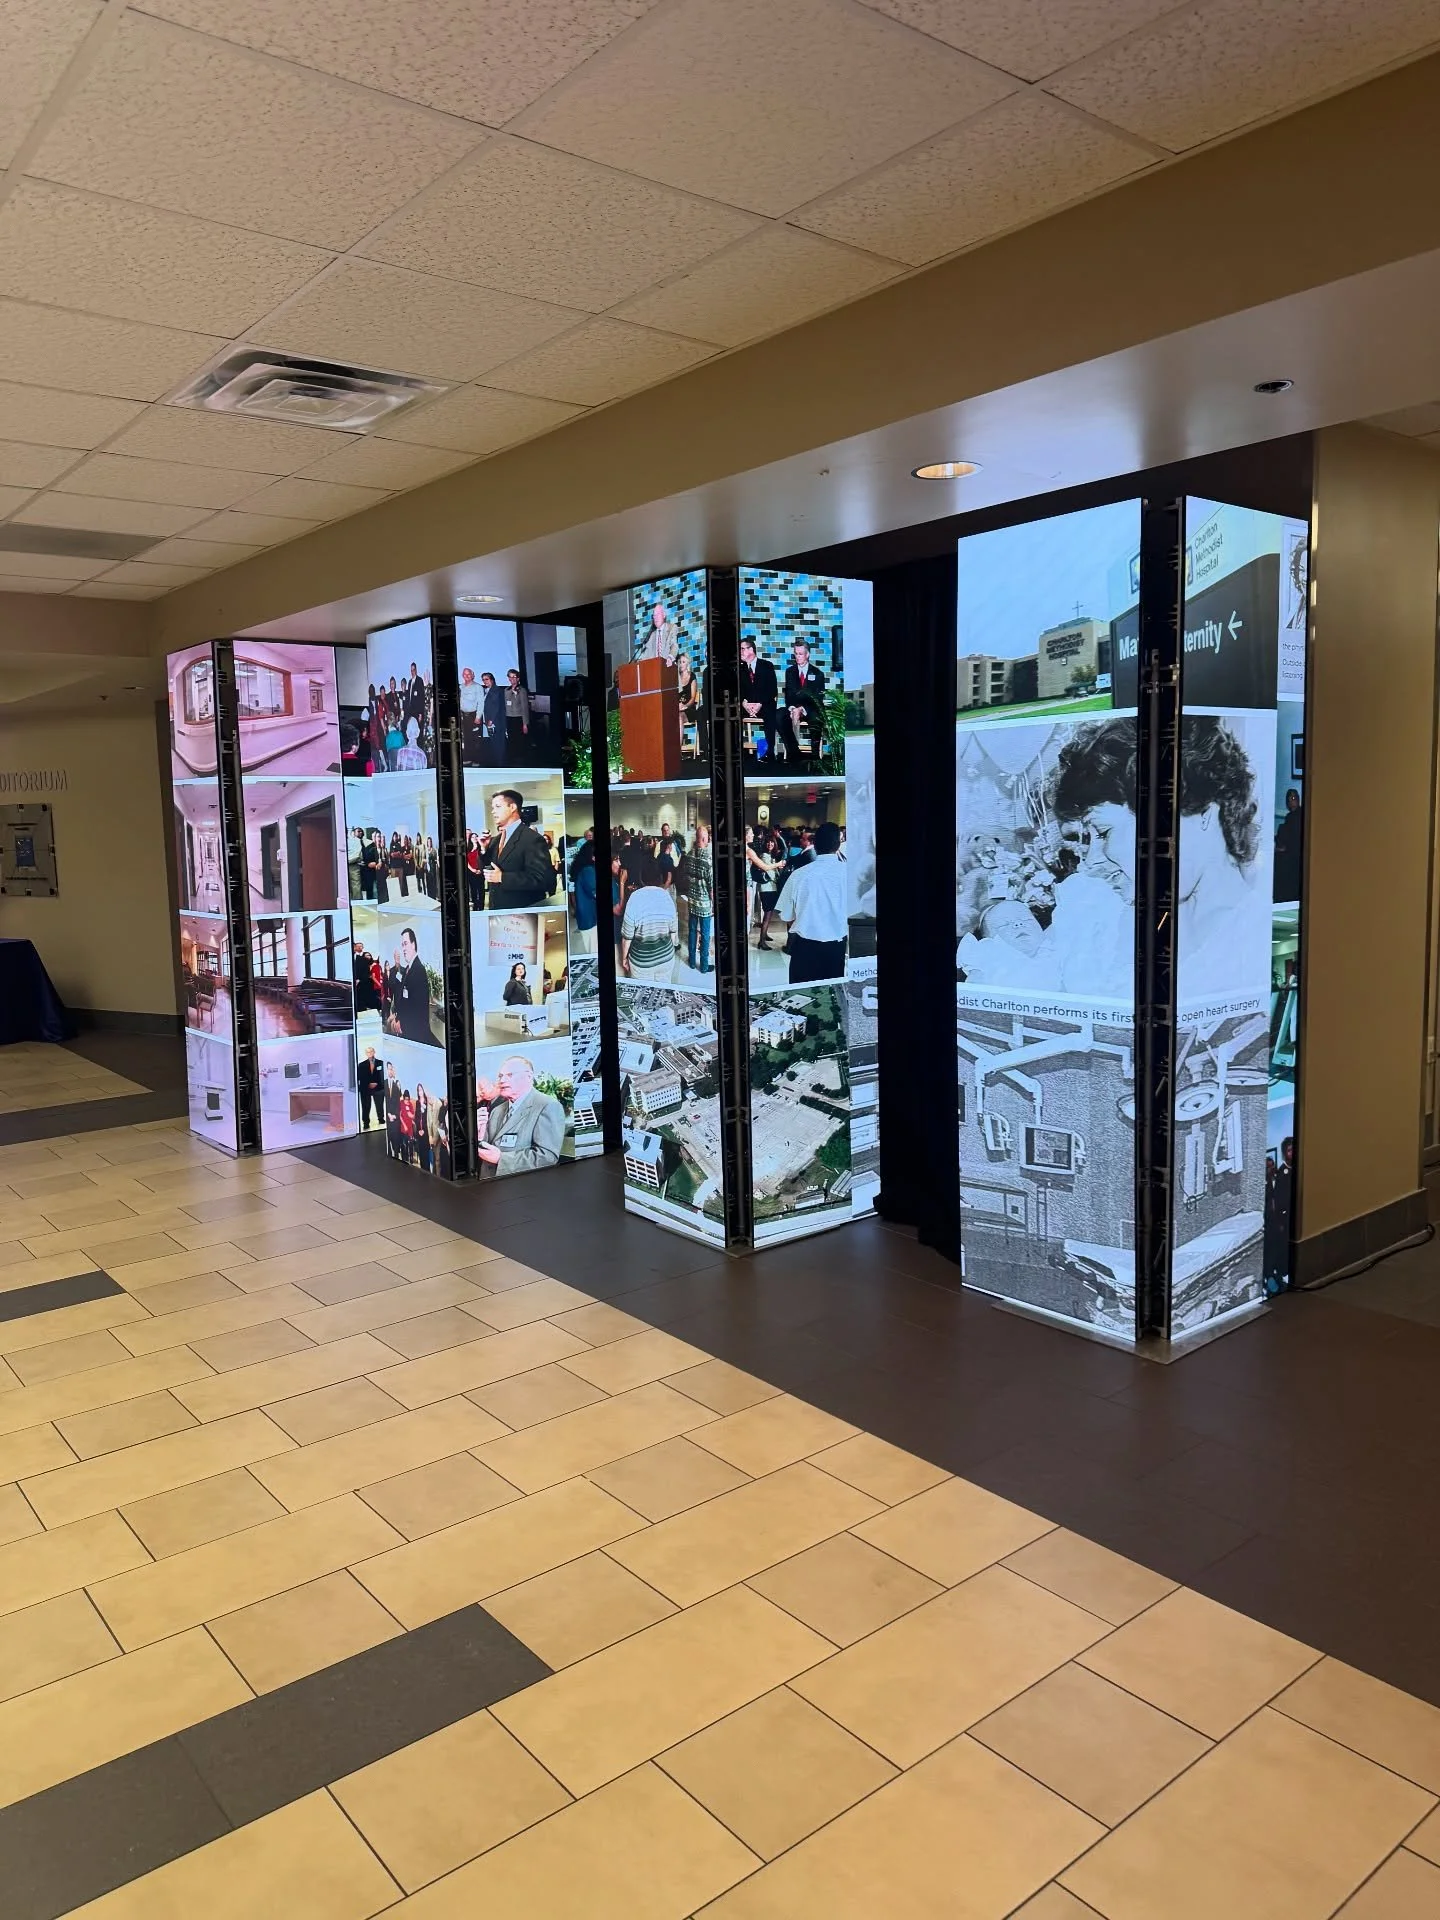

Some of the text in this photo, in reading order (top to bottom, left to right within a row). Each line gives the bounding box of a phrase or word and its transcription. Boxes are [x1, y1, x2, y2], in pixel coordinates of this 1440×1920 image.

[1194, 522, 1218, 549] Charlton
[1195, 534, 1223, 563] Methodist
[1196, 554, 1219, 580] Hospital
[981, 998, 1030, 1013] Charlton
[1033, 1004, 1088, 1019] performs
[1092, 1009, 1107, 1021] its
[1181, 1010, 1203, 1023] open
[1206, 1005, 1228, 1017] heart
[1229, 999, 1260, 1012] surgery
